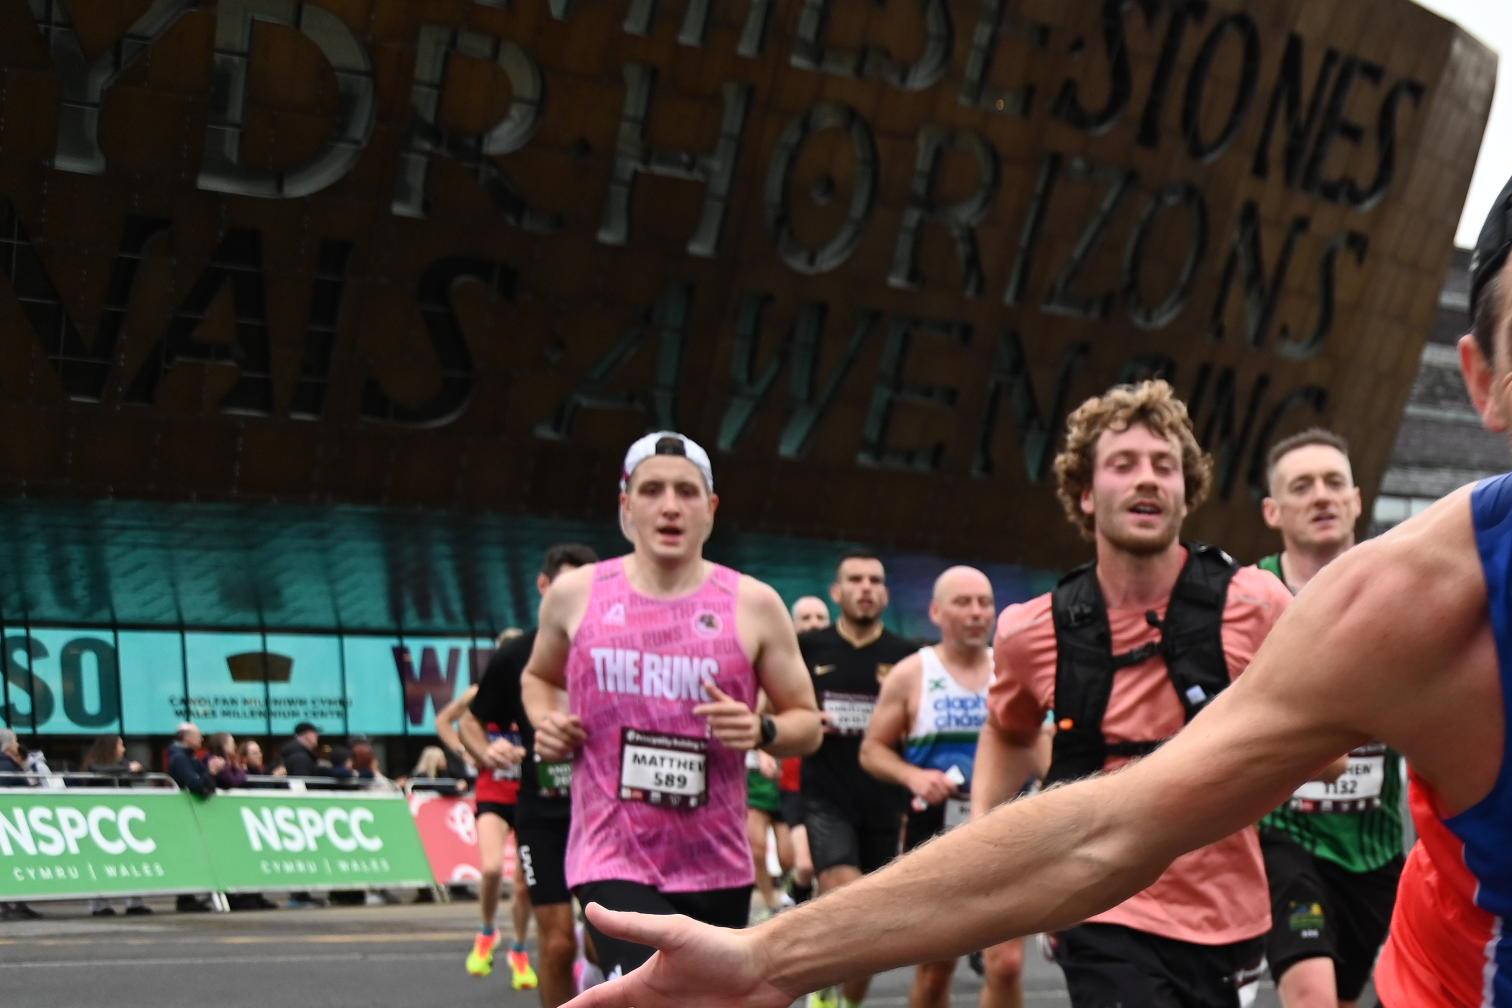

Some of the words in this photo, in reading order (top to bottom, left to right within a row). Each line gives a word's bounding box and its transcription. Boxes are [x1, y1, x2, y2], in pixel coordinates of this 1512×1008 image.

[1050, 0, 1427, 213] STONES
[597, 60, 1370, 360] HORIZONS
[533, 278, 1090, 484] AWEN
[0, 635, 117, 728] SO
[590, 647, 641, 694] THE
[643, 652, 720, 703] RUNS
[654, 771, 687, 789] 589
[0, 805, 157, 856] NSPCC
[239, 805, 384, 852] NSPCC
[13, 864, 80, 881] CYMRU
[103, 862, 165, 879] WALES
